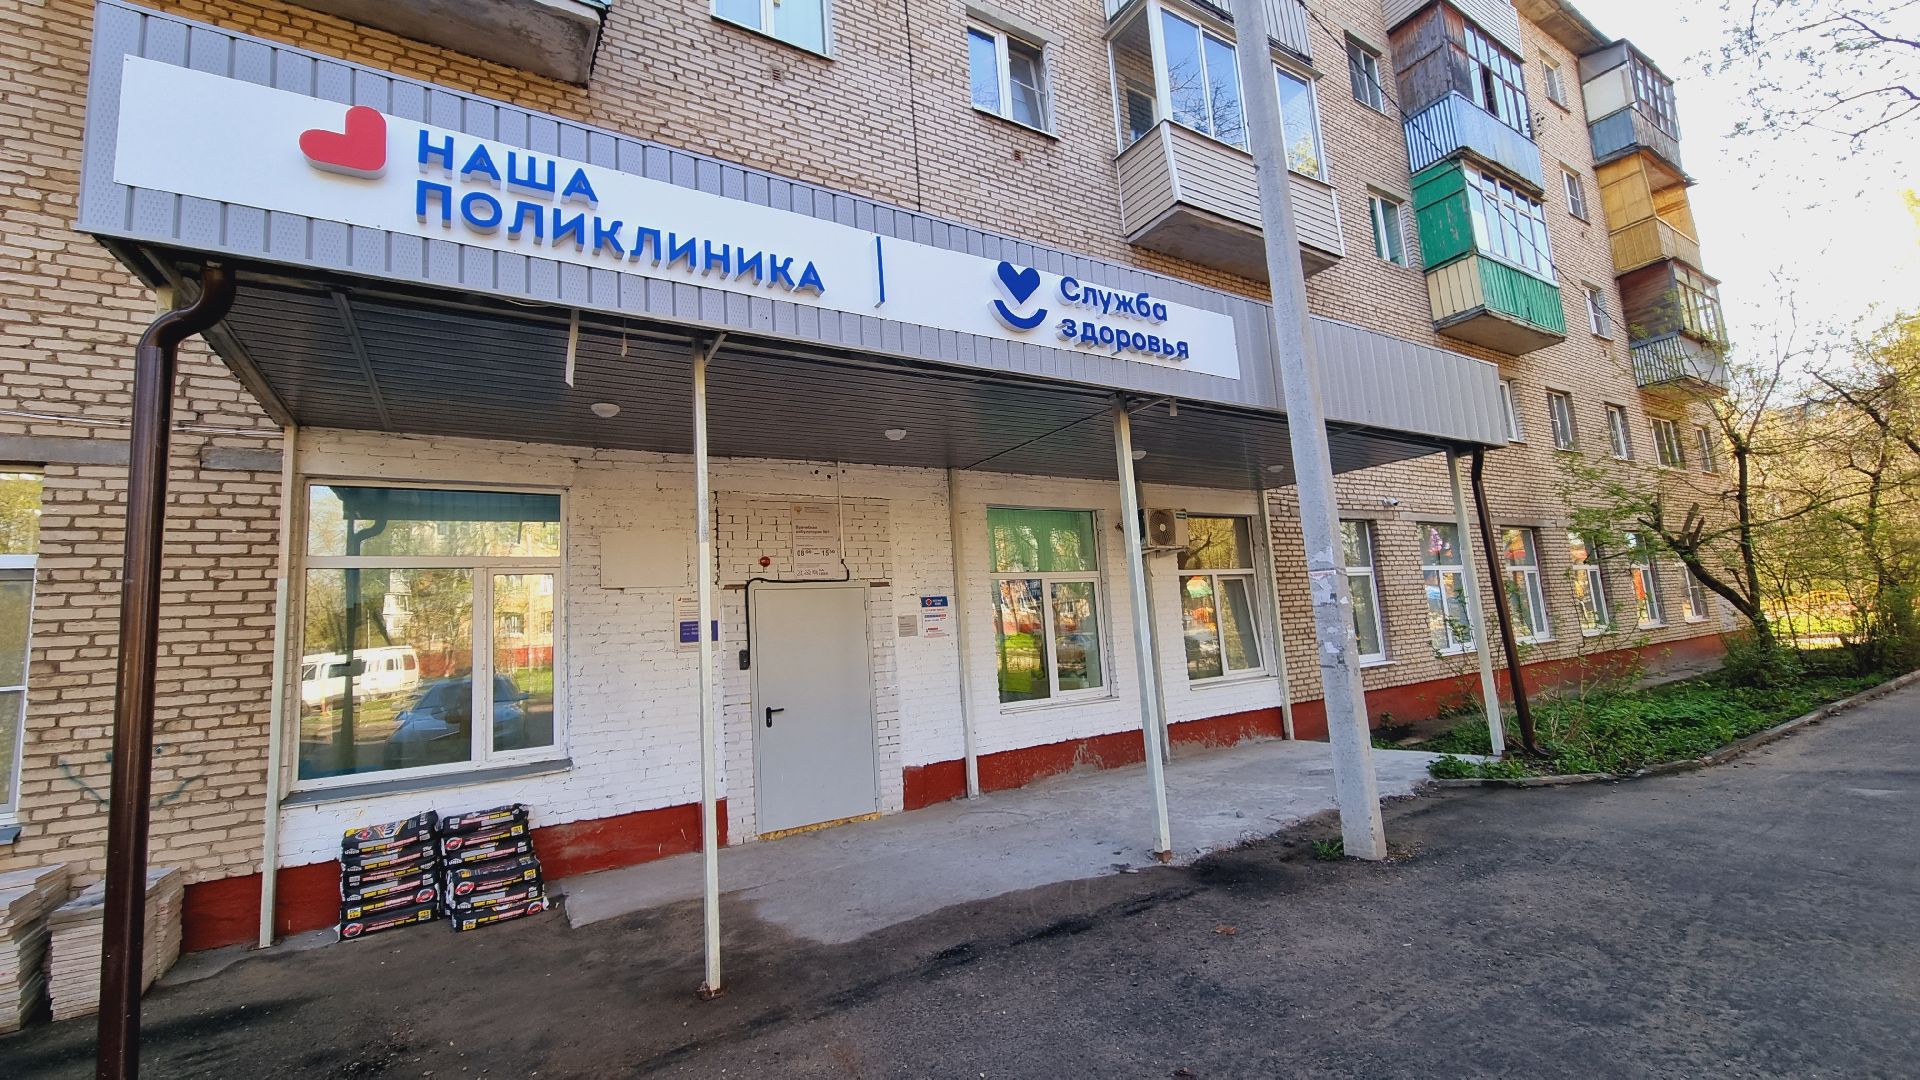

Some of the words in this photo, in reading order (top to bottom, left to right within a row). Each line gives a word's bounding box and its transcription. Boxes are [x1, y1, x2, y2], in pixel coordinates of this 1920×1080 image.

[418, 129, 600, 205] НАША
[416, 180, 826, 294] ПОЛИКЛИНИКА
[1059, 275, 1169, 323] Служба
[1060, 317, 1190, 361] здоровья
